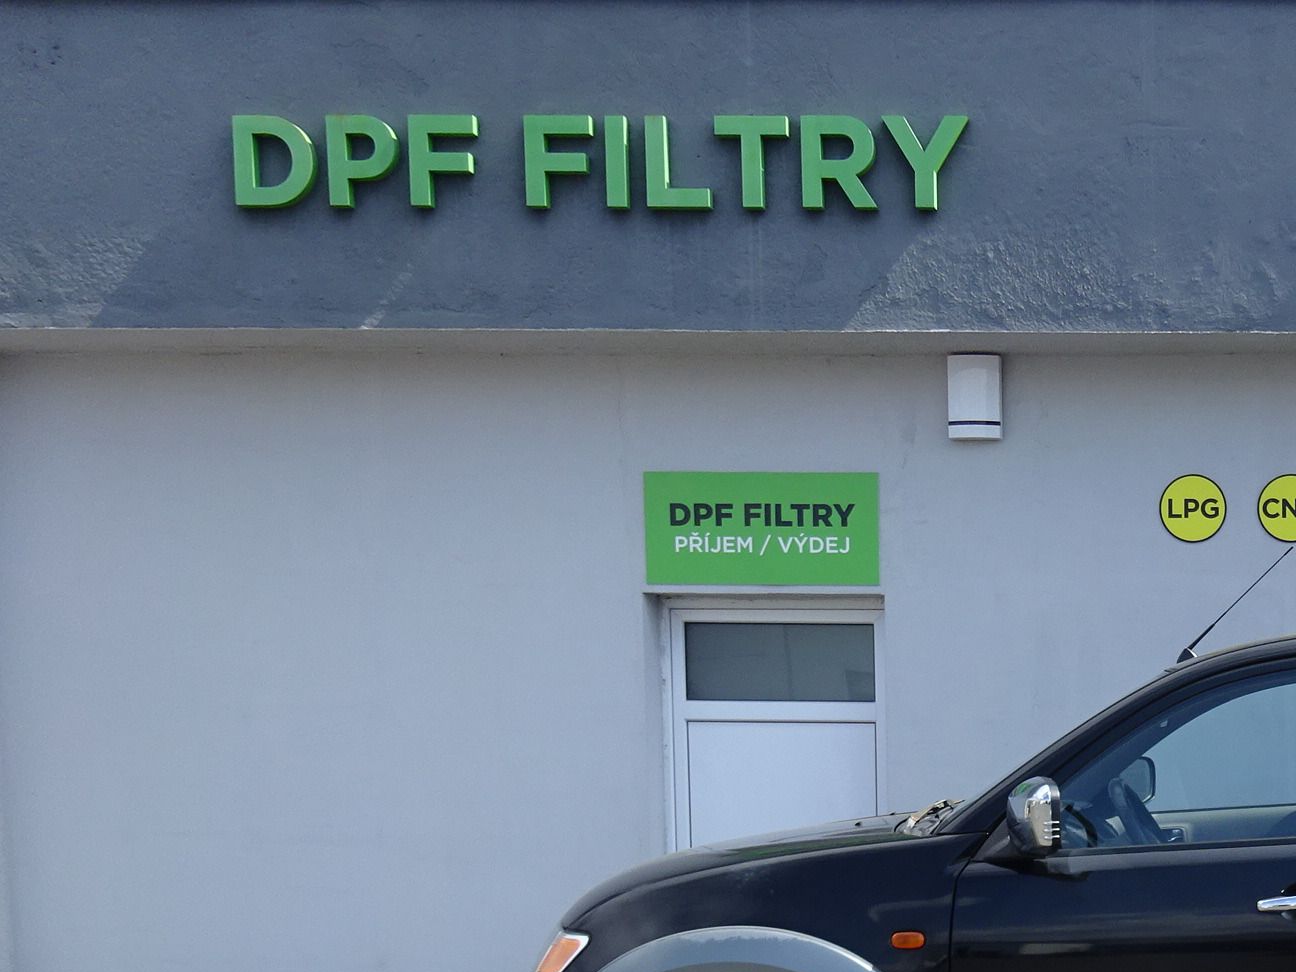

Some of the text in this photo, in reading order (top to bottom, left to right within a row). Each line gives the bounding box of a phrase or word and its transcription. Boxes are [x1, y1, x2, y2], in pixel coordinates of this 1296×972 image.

[232, 114, 970, 212] DPF FILTRY
[669, 502, 856, 528] DPF FILTRY
[1167, 498, 1220, 519] LPG
[674, 532, 753, 553] PŘÍJEM
[777, 532, 851, 554] VÝDEJ
